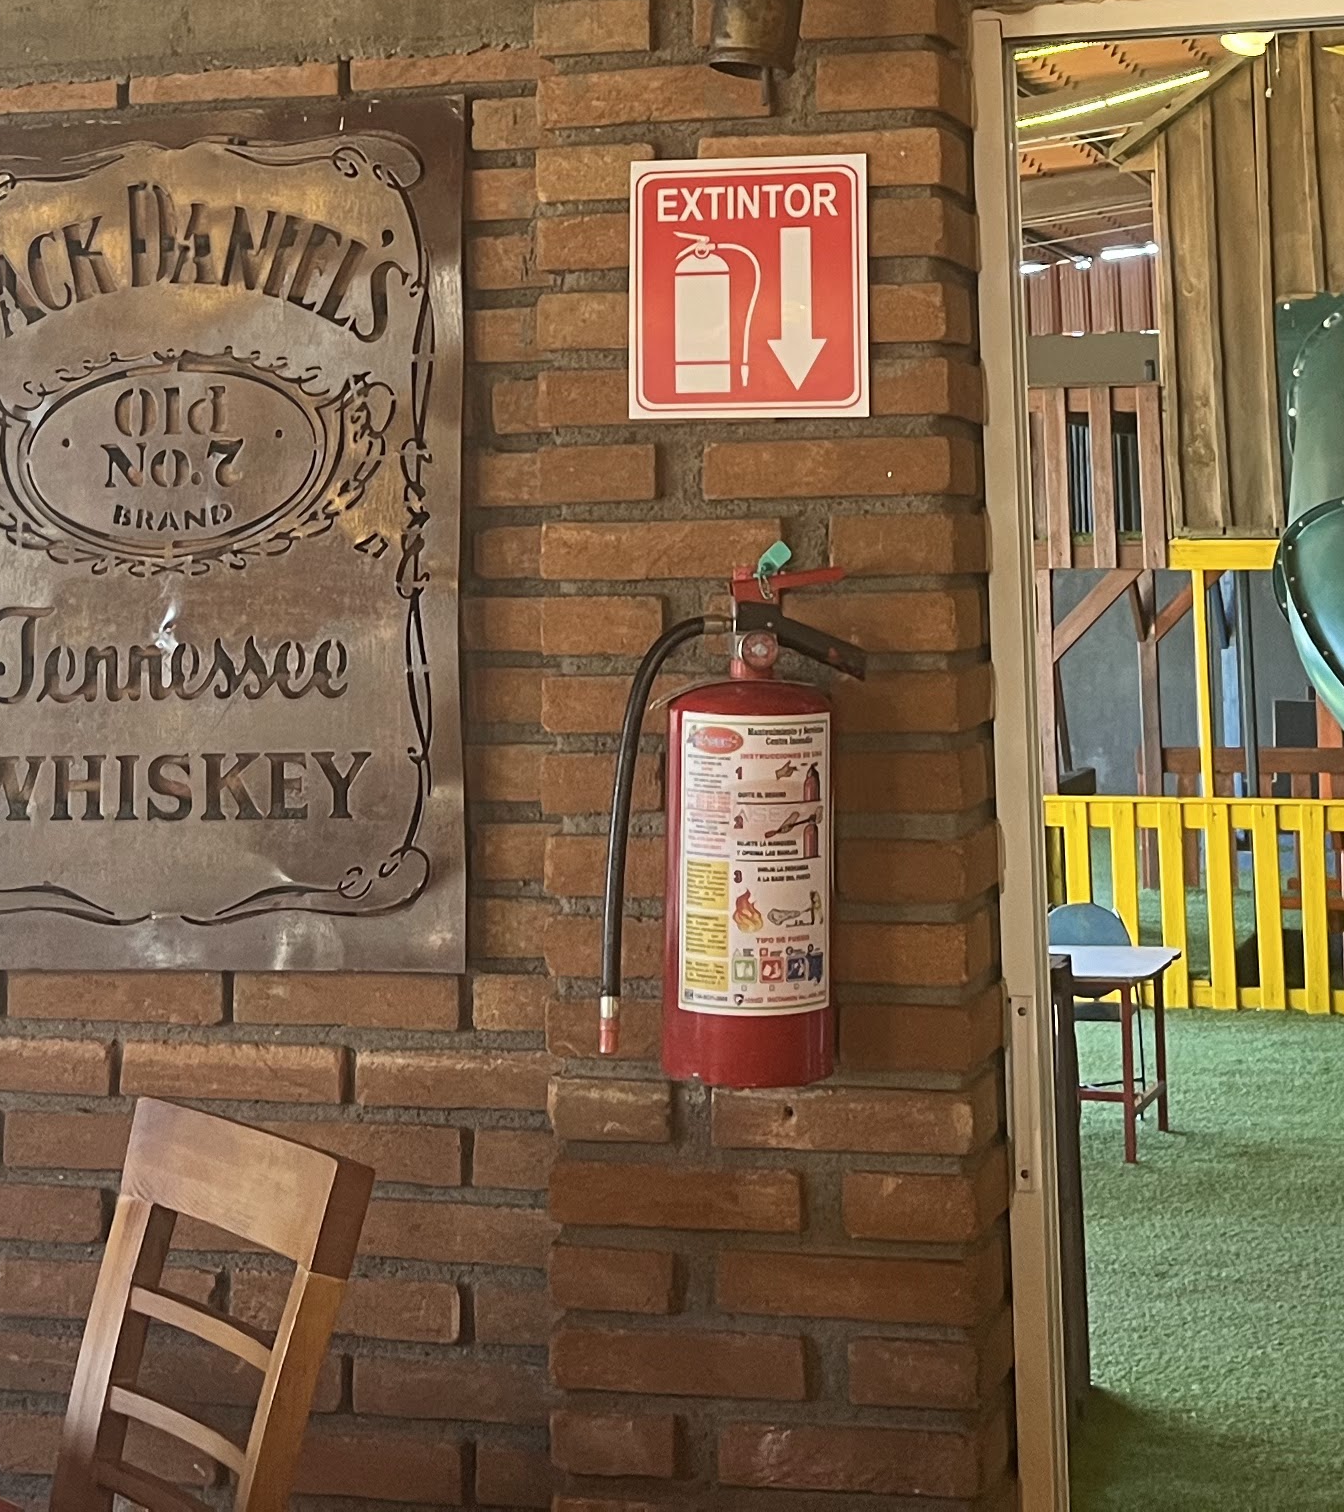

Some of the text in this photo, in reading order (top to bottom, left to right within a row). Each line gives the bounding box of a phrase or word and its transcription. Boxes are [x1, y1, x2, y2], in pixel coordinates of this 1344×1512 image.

[657, 182, 839, 223] EXTINTOR
[126, 180, 409, 343] DANIEL'S
[114, 385, 229, 438] Old
[112, 503, 233, 532] BRAND
